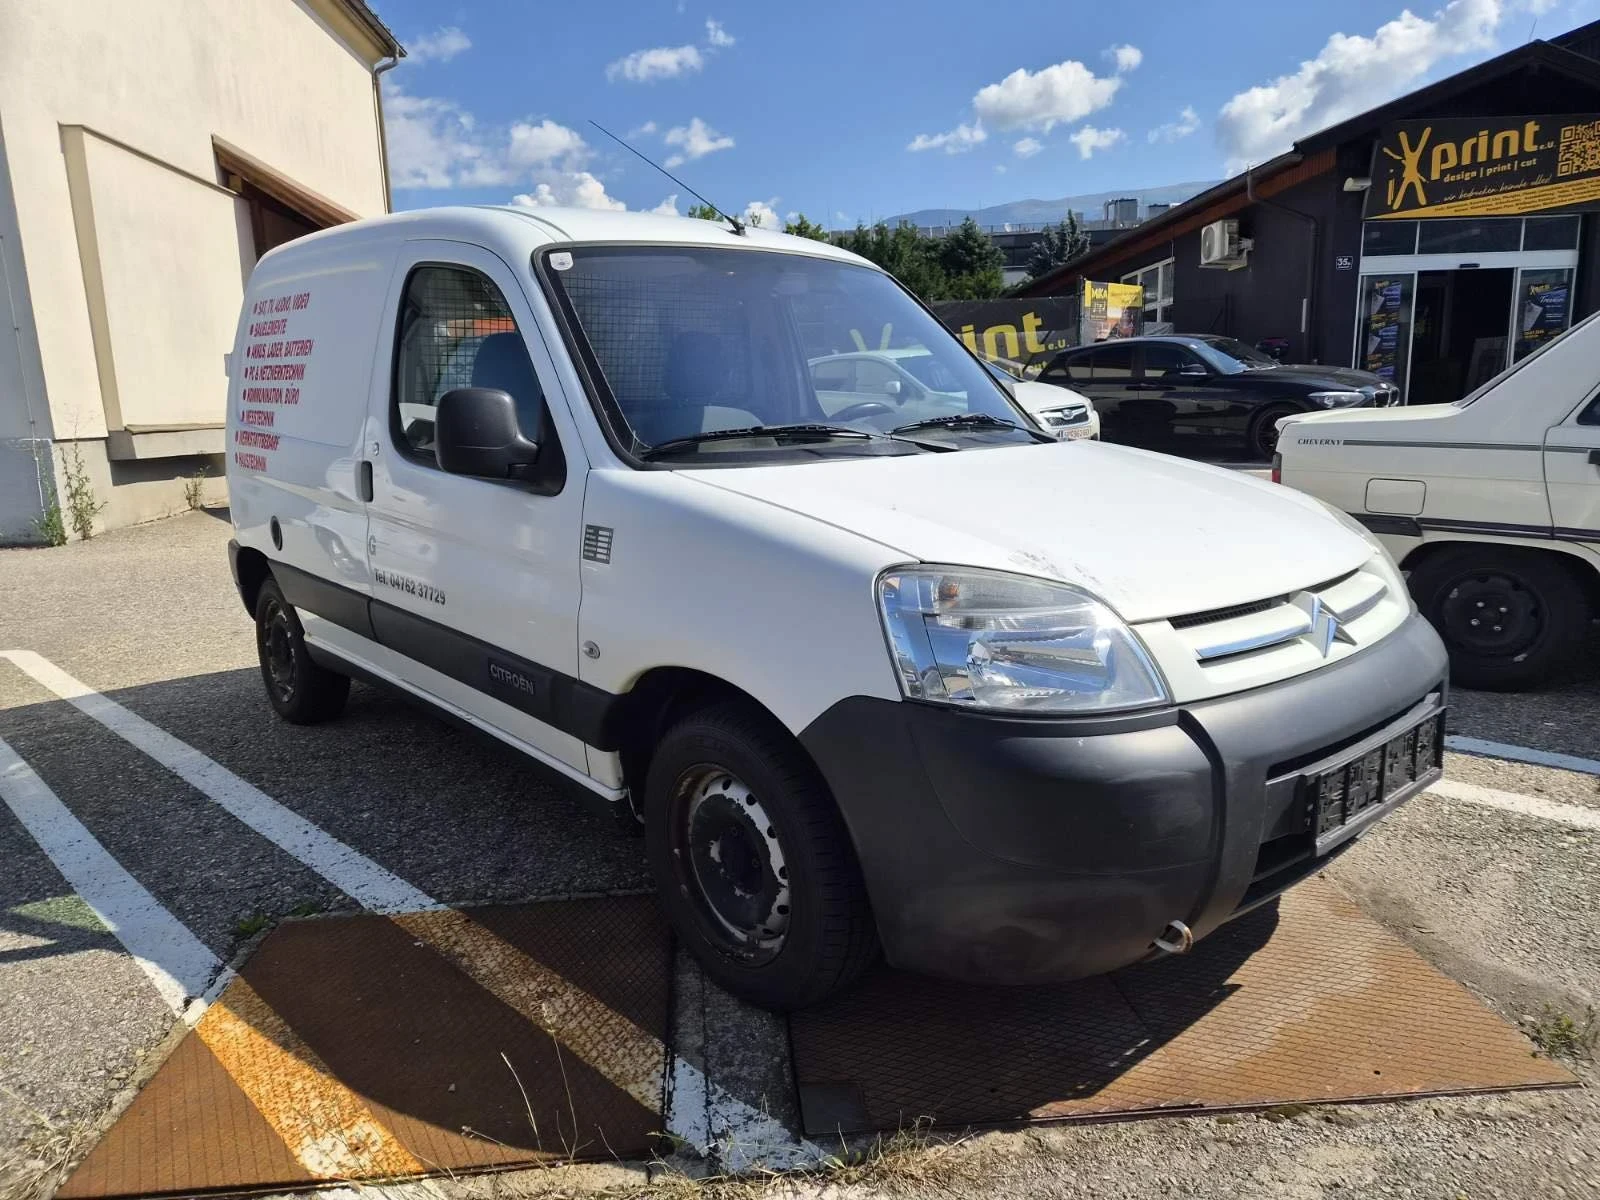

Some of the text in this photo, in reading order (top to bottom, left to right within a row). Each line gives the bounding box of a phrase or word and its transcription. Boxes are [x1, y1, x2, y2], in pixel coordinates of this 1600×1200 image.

[1443, 170, 1477, 183] design
[1486, 163, 1512, 175] print
[1520, 158, 1537, 168] cut
[284, 339, 315, 357] BATTERIEN
[259, 364, 306, 381] NETZWERKTECHNIK
[1298, 438, 1342, 446] CHEVERNY
[373, 567, 446, 605] Tel. 04762 37729
